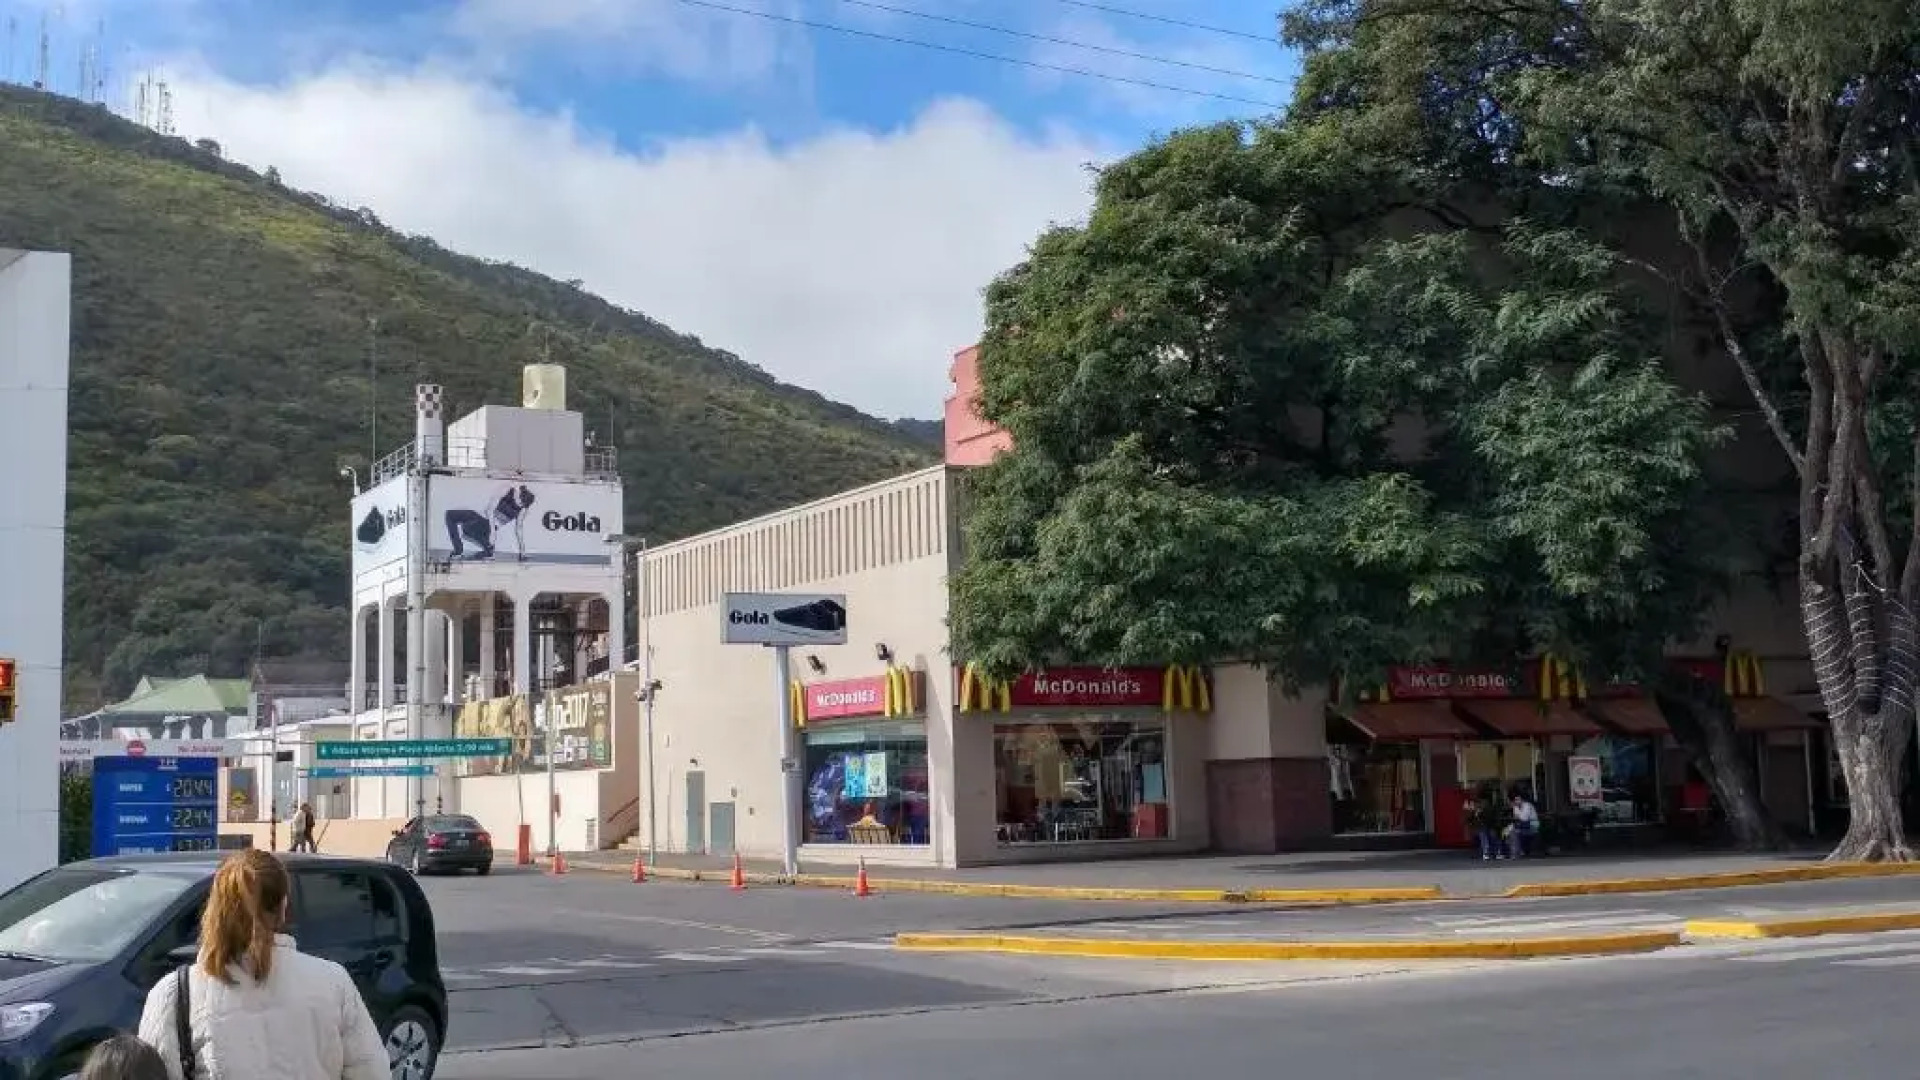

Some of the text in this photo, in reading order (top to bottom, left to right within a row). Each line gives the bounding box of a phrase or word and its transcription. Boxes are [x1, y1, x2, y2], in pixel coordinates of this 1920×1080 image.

[542, 510, 601, 533] Gola
[729, 608, 769, 625] Gola
[1034, 679, 1141, 695] McDonald's
